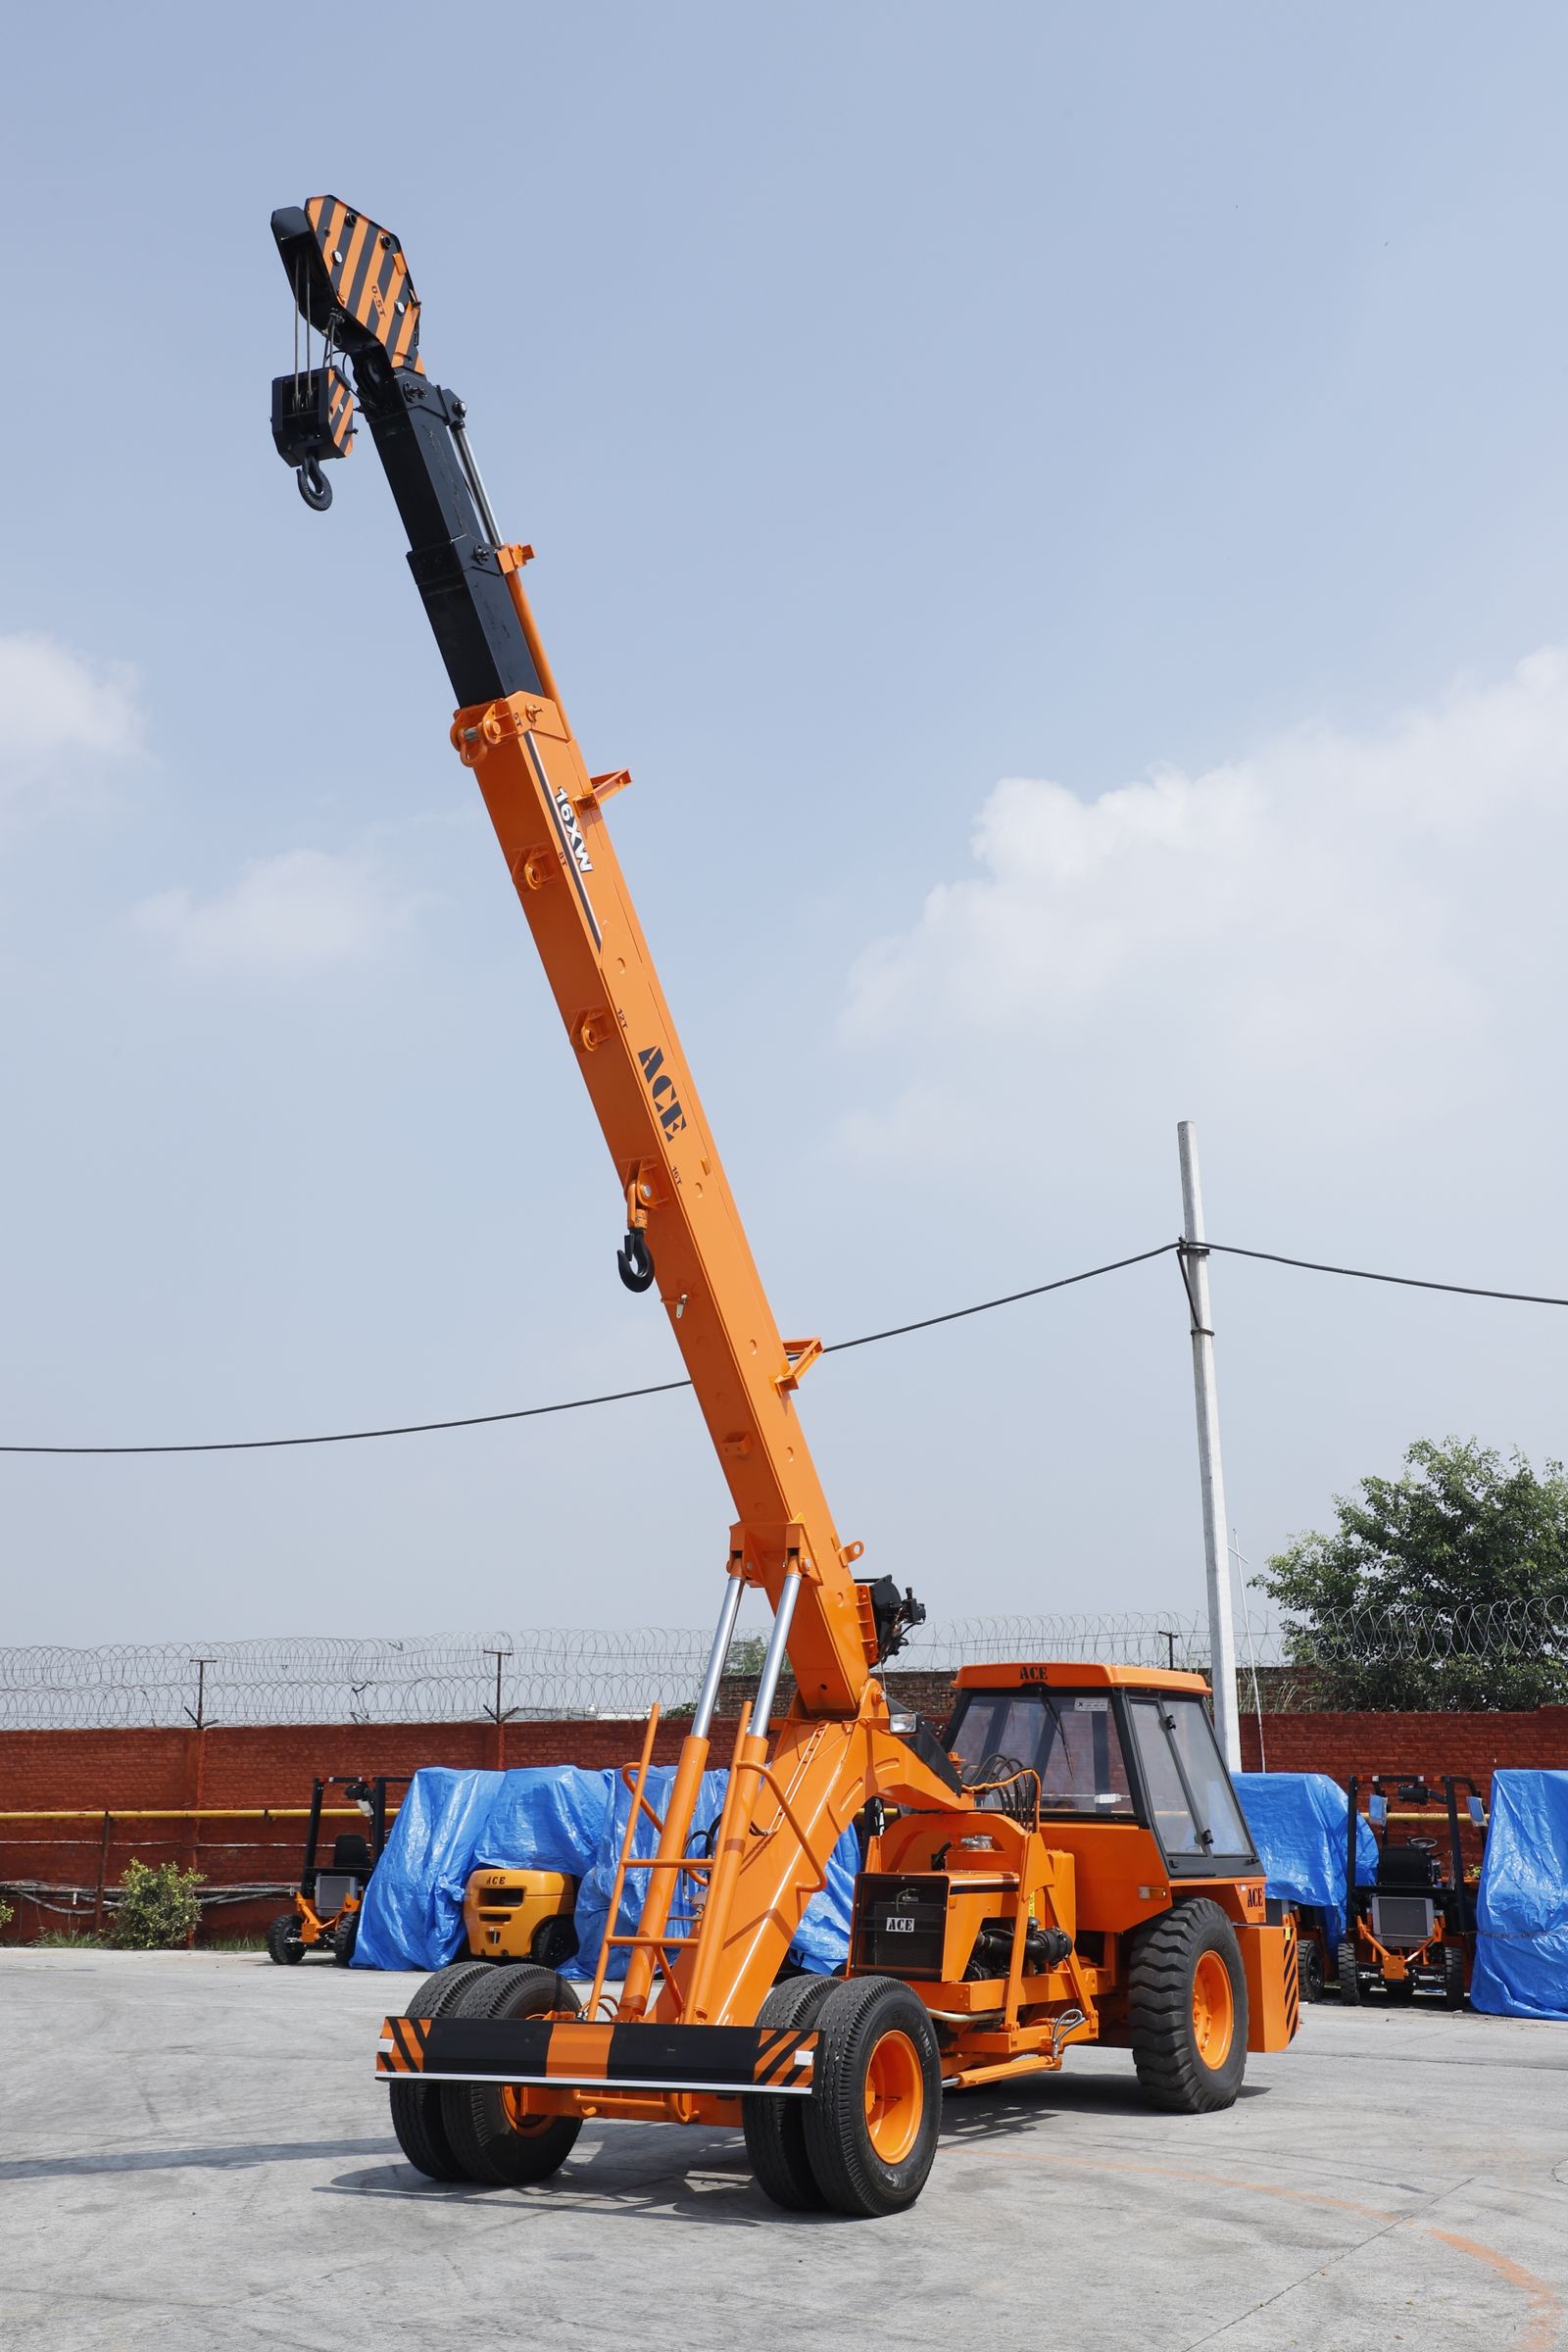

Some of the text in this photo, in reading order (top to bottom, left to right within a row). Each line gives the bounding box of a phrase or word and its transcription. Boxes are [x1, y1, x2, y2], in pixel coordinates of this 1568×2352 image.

[555, 785, 594, 872] 16XW
[617, 1008, 628, 1029] 12T
[637, 1045, 688, 1143] ACE
[671, 1165, 682, 1186] 16T
[1019, 1666, 1049, 1680] ACE
[486, 1876, 506, 1885] ACE
[1247, 1886, 1263, 1907] ACE
[888, 1918, 912, 1931] ACE
